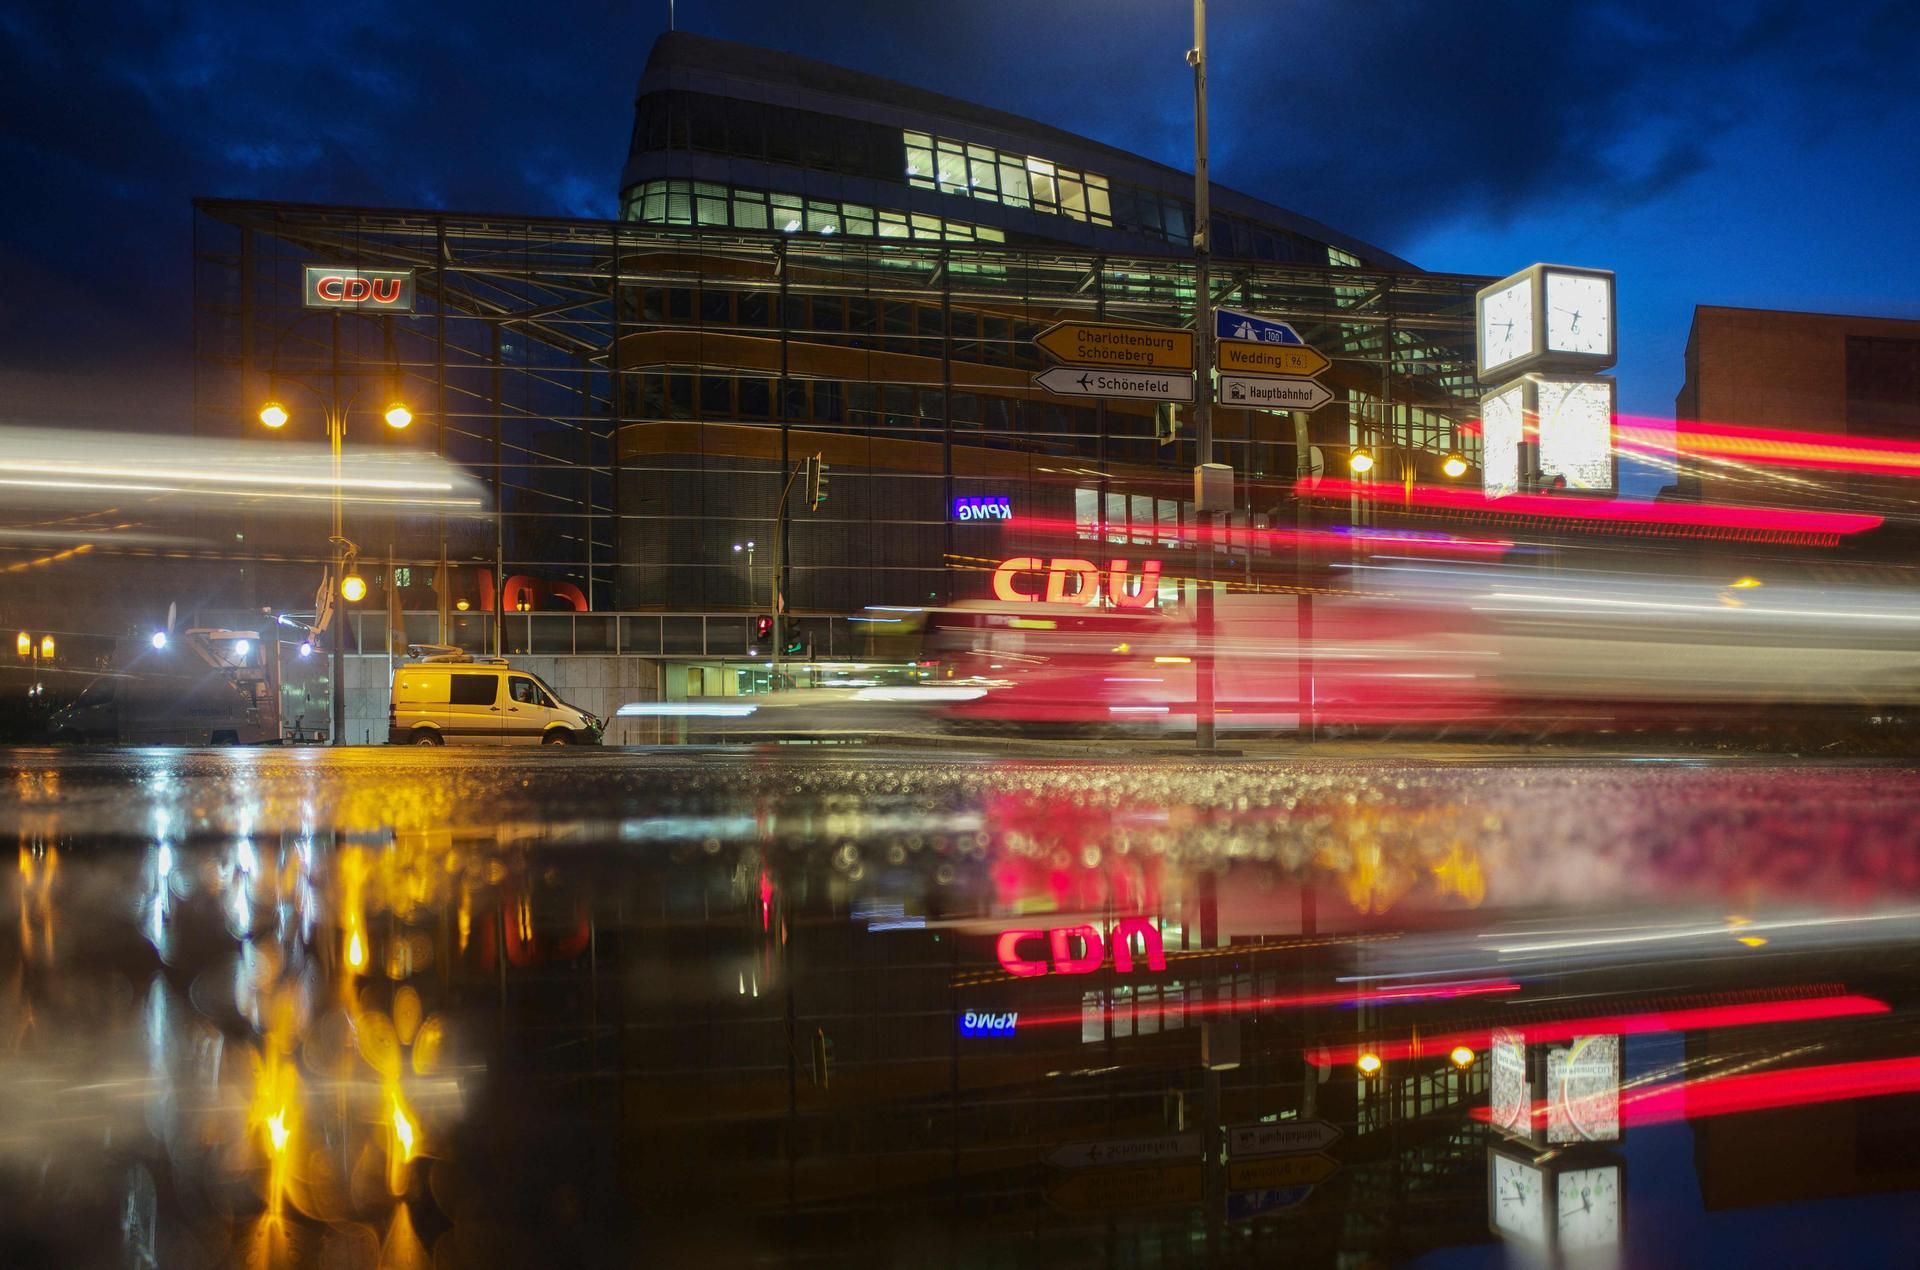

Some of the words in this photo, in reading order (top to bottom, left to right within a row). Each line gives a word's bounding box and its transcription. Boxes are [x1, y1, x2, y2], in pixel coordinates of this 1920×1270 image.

[317, 276, 401, 303] CDU
[1077, 330, 1175, 350] Charlottenburg
[1267, 331, 1280, 342] 100
[1077, 346, 1155, 364] Schöneberg
[1230, 350, 1283, 368] Wedding
[1291, 356, 1303, 366] 96
[1097, 377, 1169, 393] Schönefeld
[1250, 386, 1313, 401] Hauptbahnhof
[993, 557, 1161, 608] CDU
[964, 1012, 1018, 1029] KPMG
